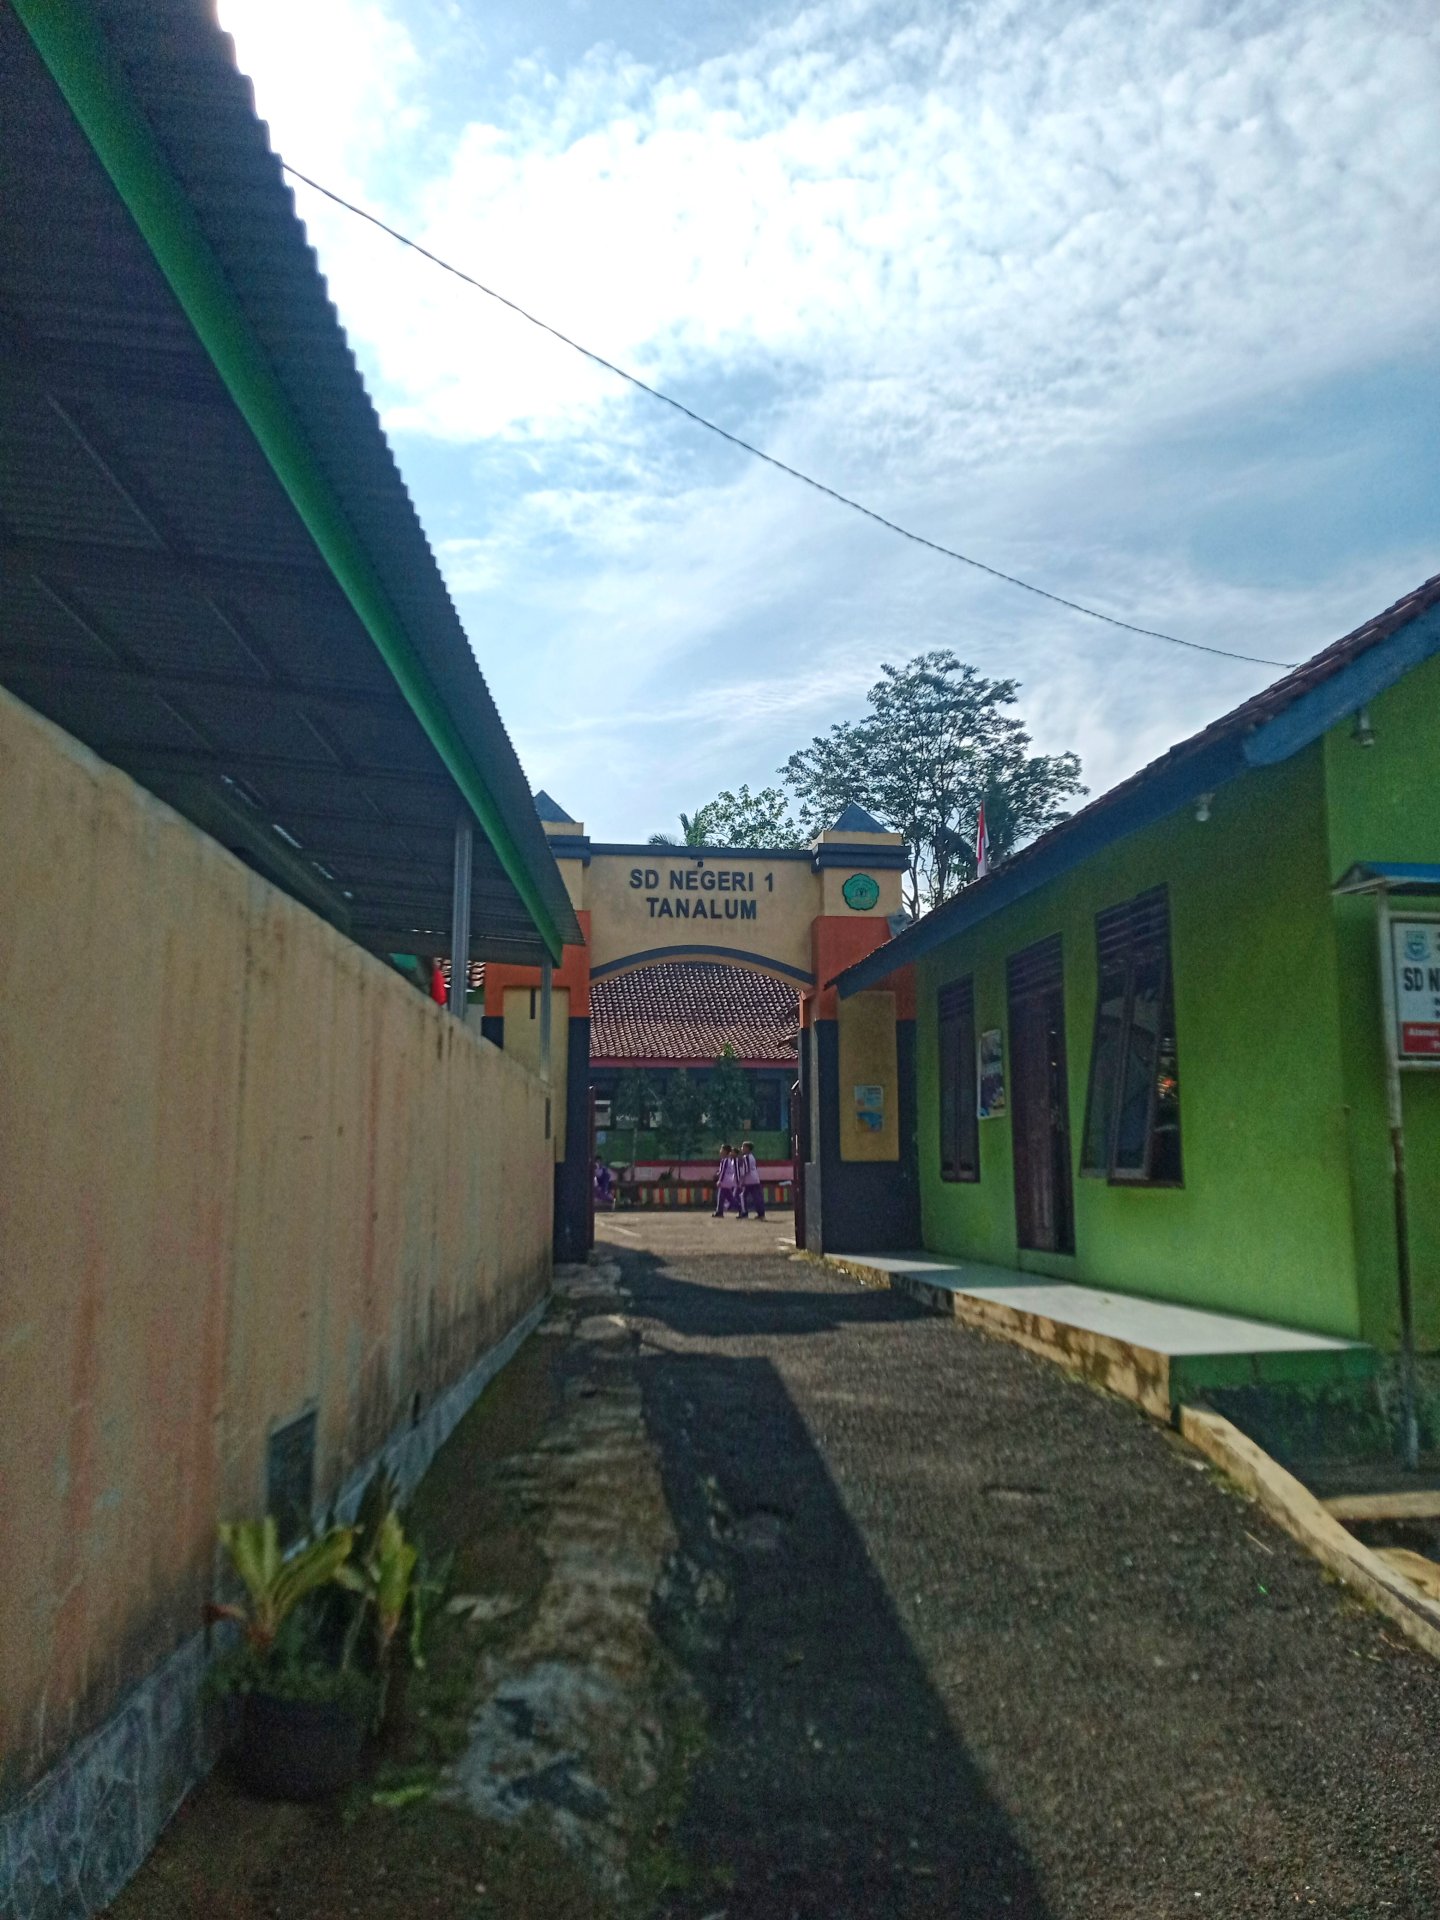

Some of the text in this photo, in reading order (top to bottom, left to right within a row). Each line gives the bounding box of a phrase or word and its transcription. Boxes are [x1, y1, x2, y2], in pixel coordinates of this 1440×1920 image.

[629, 869, 774, 892] SD NEGERI 1
[646, 897, 757, 920] TANALUM
[1404, 967, 1424, 992] SD
